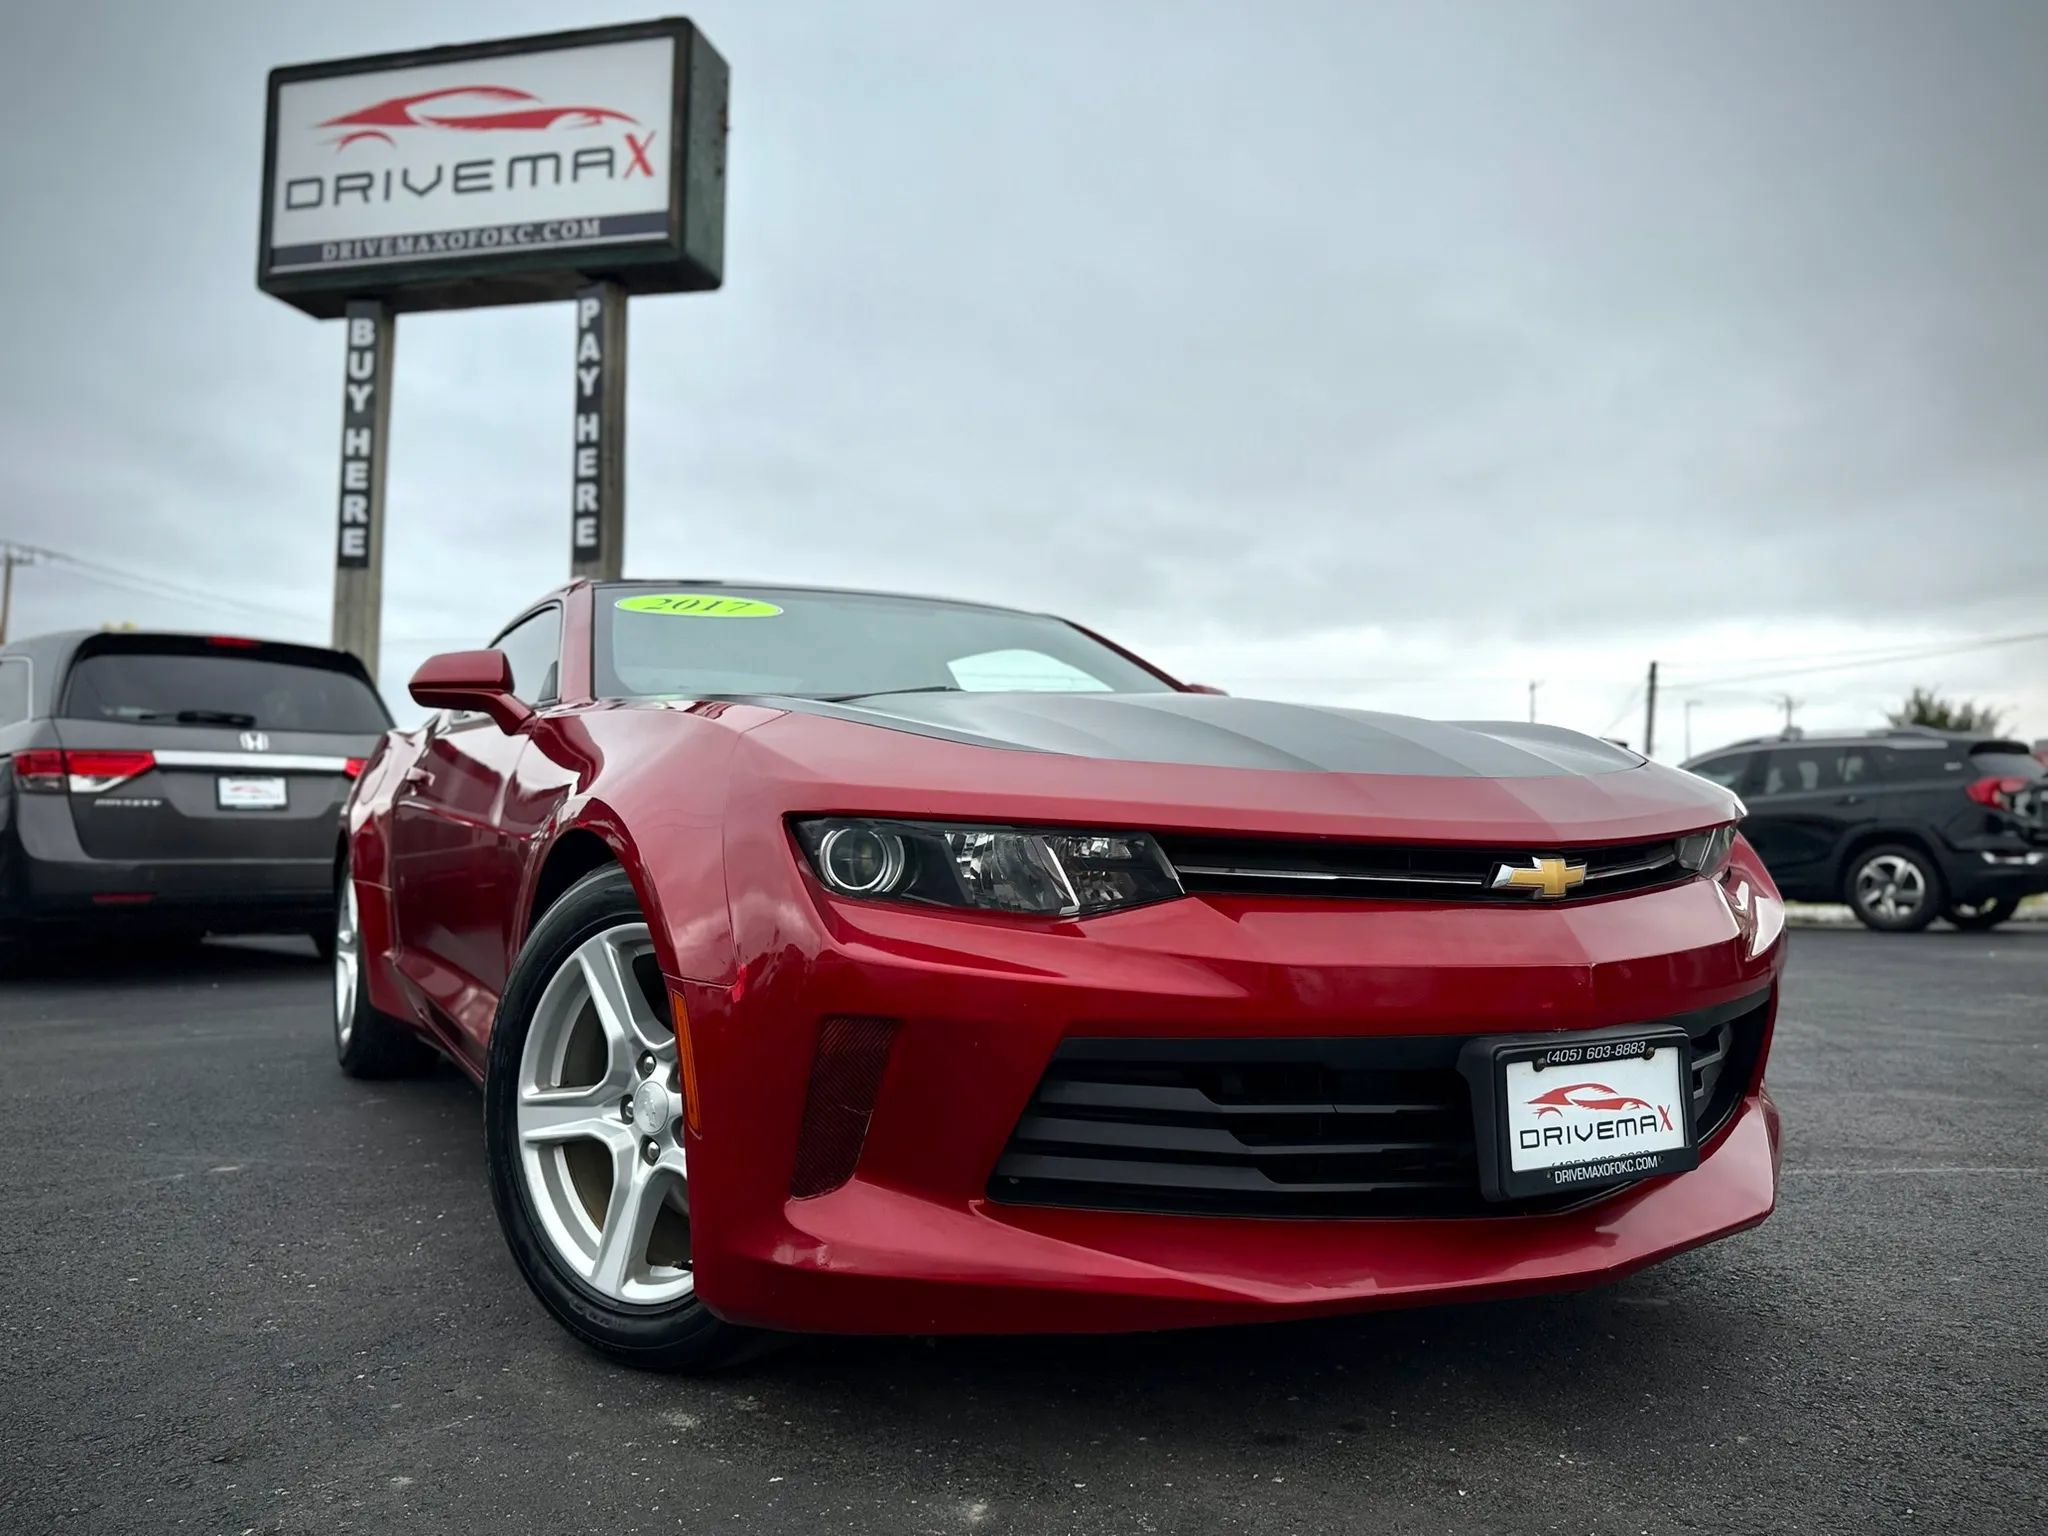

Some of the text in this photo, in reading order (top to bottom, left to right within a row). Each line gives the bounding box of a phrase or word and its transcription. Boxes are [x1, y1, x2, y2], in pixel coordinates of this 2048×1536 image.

[285, 130, 656, 211] DRIVEMAX
[321, 218, 601, 262] DRIVEMAXOFOKC.COM
[341, 317, 375, 557] BUY HERE
[575, 298, 601, 547] PAY HERE
[643, 598, 752, 613] 2017
[1546, 1041, 1646, 1064] (405) 603-8883
[1519, 1104, 1673, 1150] DRIVEMAX
[1554, 1155, 1658, 1184] DRIVEMAXOFOKC.COM
